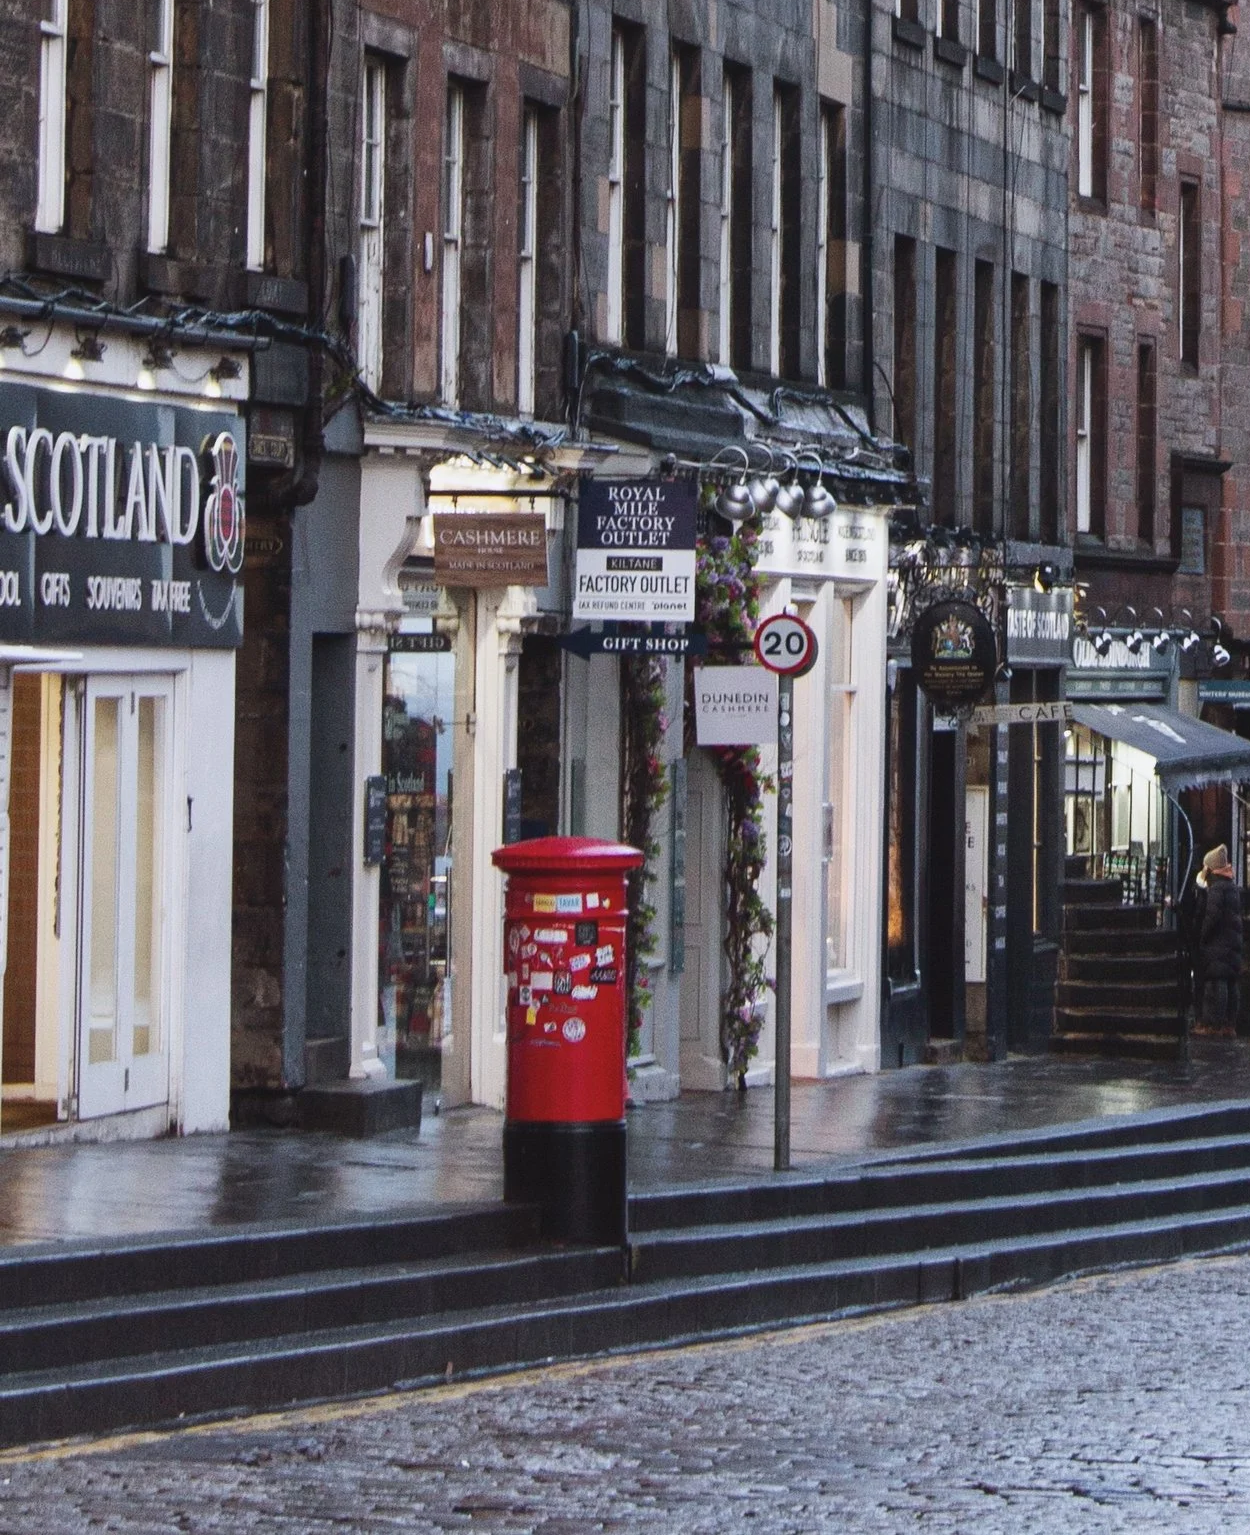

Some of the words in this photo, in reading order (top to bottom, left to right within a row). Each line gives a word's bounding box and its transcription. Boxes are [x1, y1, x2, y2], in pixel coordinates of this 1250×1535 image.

[4, 425, 200, 546] SCOTLAND
[608, 486, 665, 501] ROYAL
[614, 501, 659, 516] MILE
[597, 516, 676, 531] FACTORY
[439, 529, 541, 546] CASHMERE
[600, 531, 670, 546] OUTLET
[449, 561, 473, 569] MADE
[476, 561, 486, 570] IN
[486, 562, 535, 571] SCOTLAND
[611, 558, 658, 570] KILTANE
[41, 572, 70, 608] GIFTS
[579, 575, 637, 593] FACTORY
[640, 576, 690, 594] OUTLET
[87, 576, 142, 611] SOUVENIRS
[151, 580, 169, 612] TAX
[169, 581, 191, 613] FREE
[592, 600, 619, 610] REFUND
[620, 601, 645, 610] CENTRE
[1037, 611, 1070, 641] SCOTLAND
[602, 637, 641, 650] GIFT
[645, 638, 689, 651] SHOP
[764, 631, 805, 656] 20
[701, 692, 769, 704] DUNEDIN
[702, 705, 769, 713] CASHMERE
